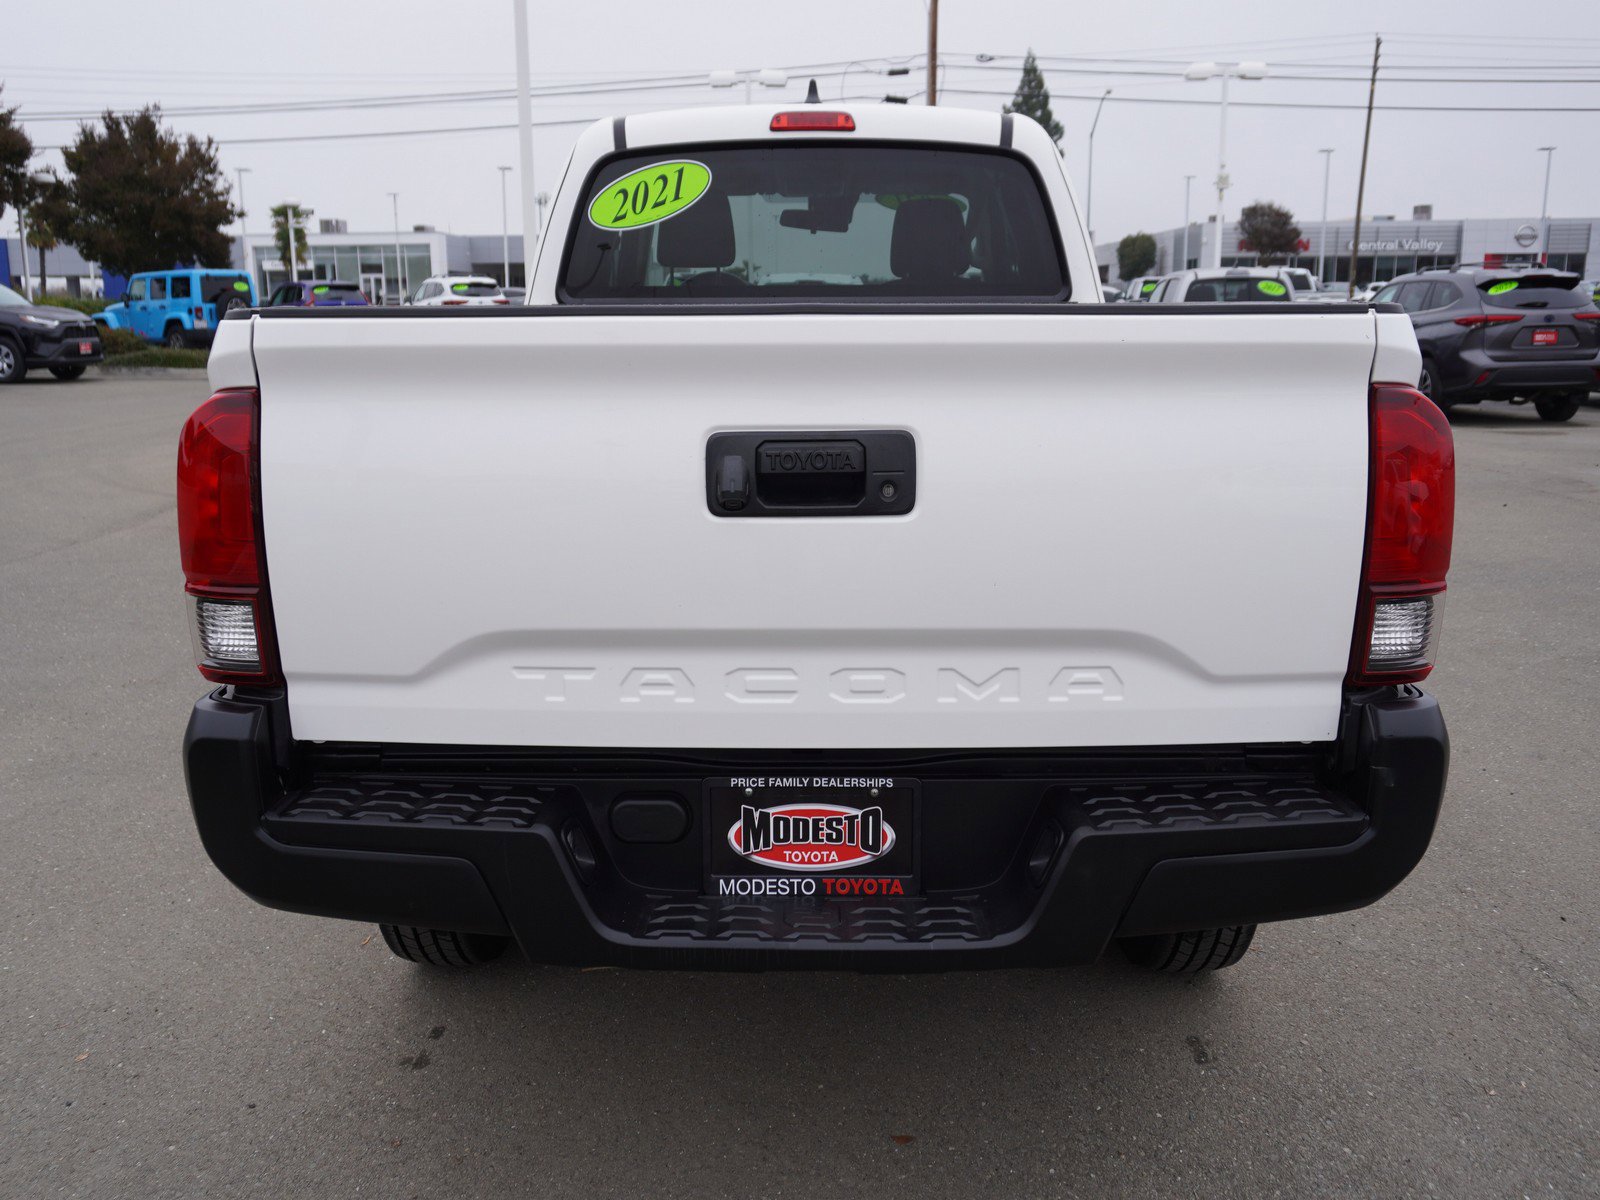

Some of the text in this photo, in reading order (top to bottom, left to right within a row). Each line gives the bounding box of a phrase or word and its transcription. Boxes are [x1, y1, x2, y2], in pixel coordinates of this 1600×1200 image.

[611, 166, 685, 224] 2021
[1402, 238, 1443, 254] Valley
[765, 451, 856, 471] TOYOTA
[511, 666, 1124, 704] TACOMA
[730, 777, 894, 788] PRICE FAMILY DEALERSHIPS
[741, 804, 883, 856] MODESTO
[783, 850, 839, 863] TOYOTA
[719, 878, 904, 896] MODESTO TOYOTA
